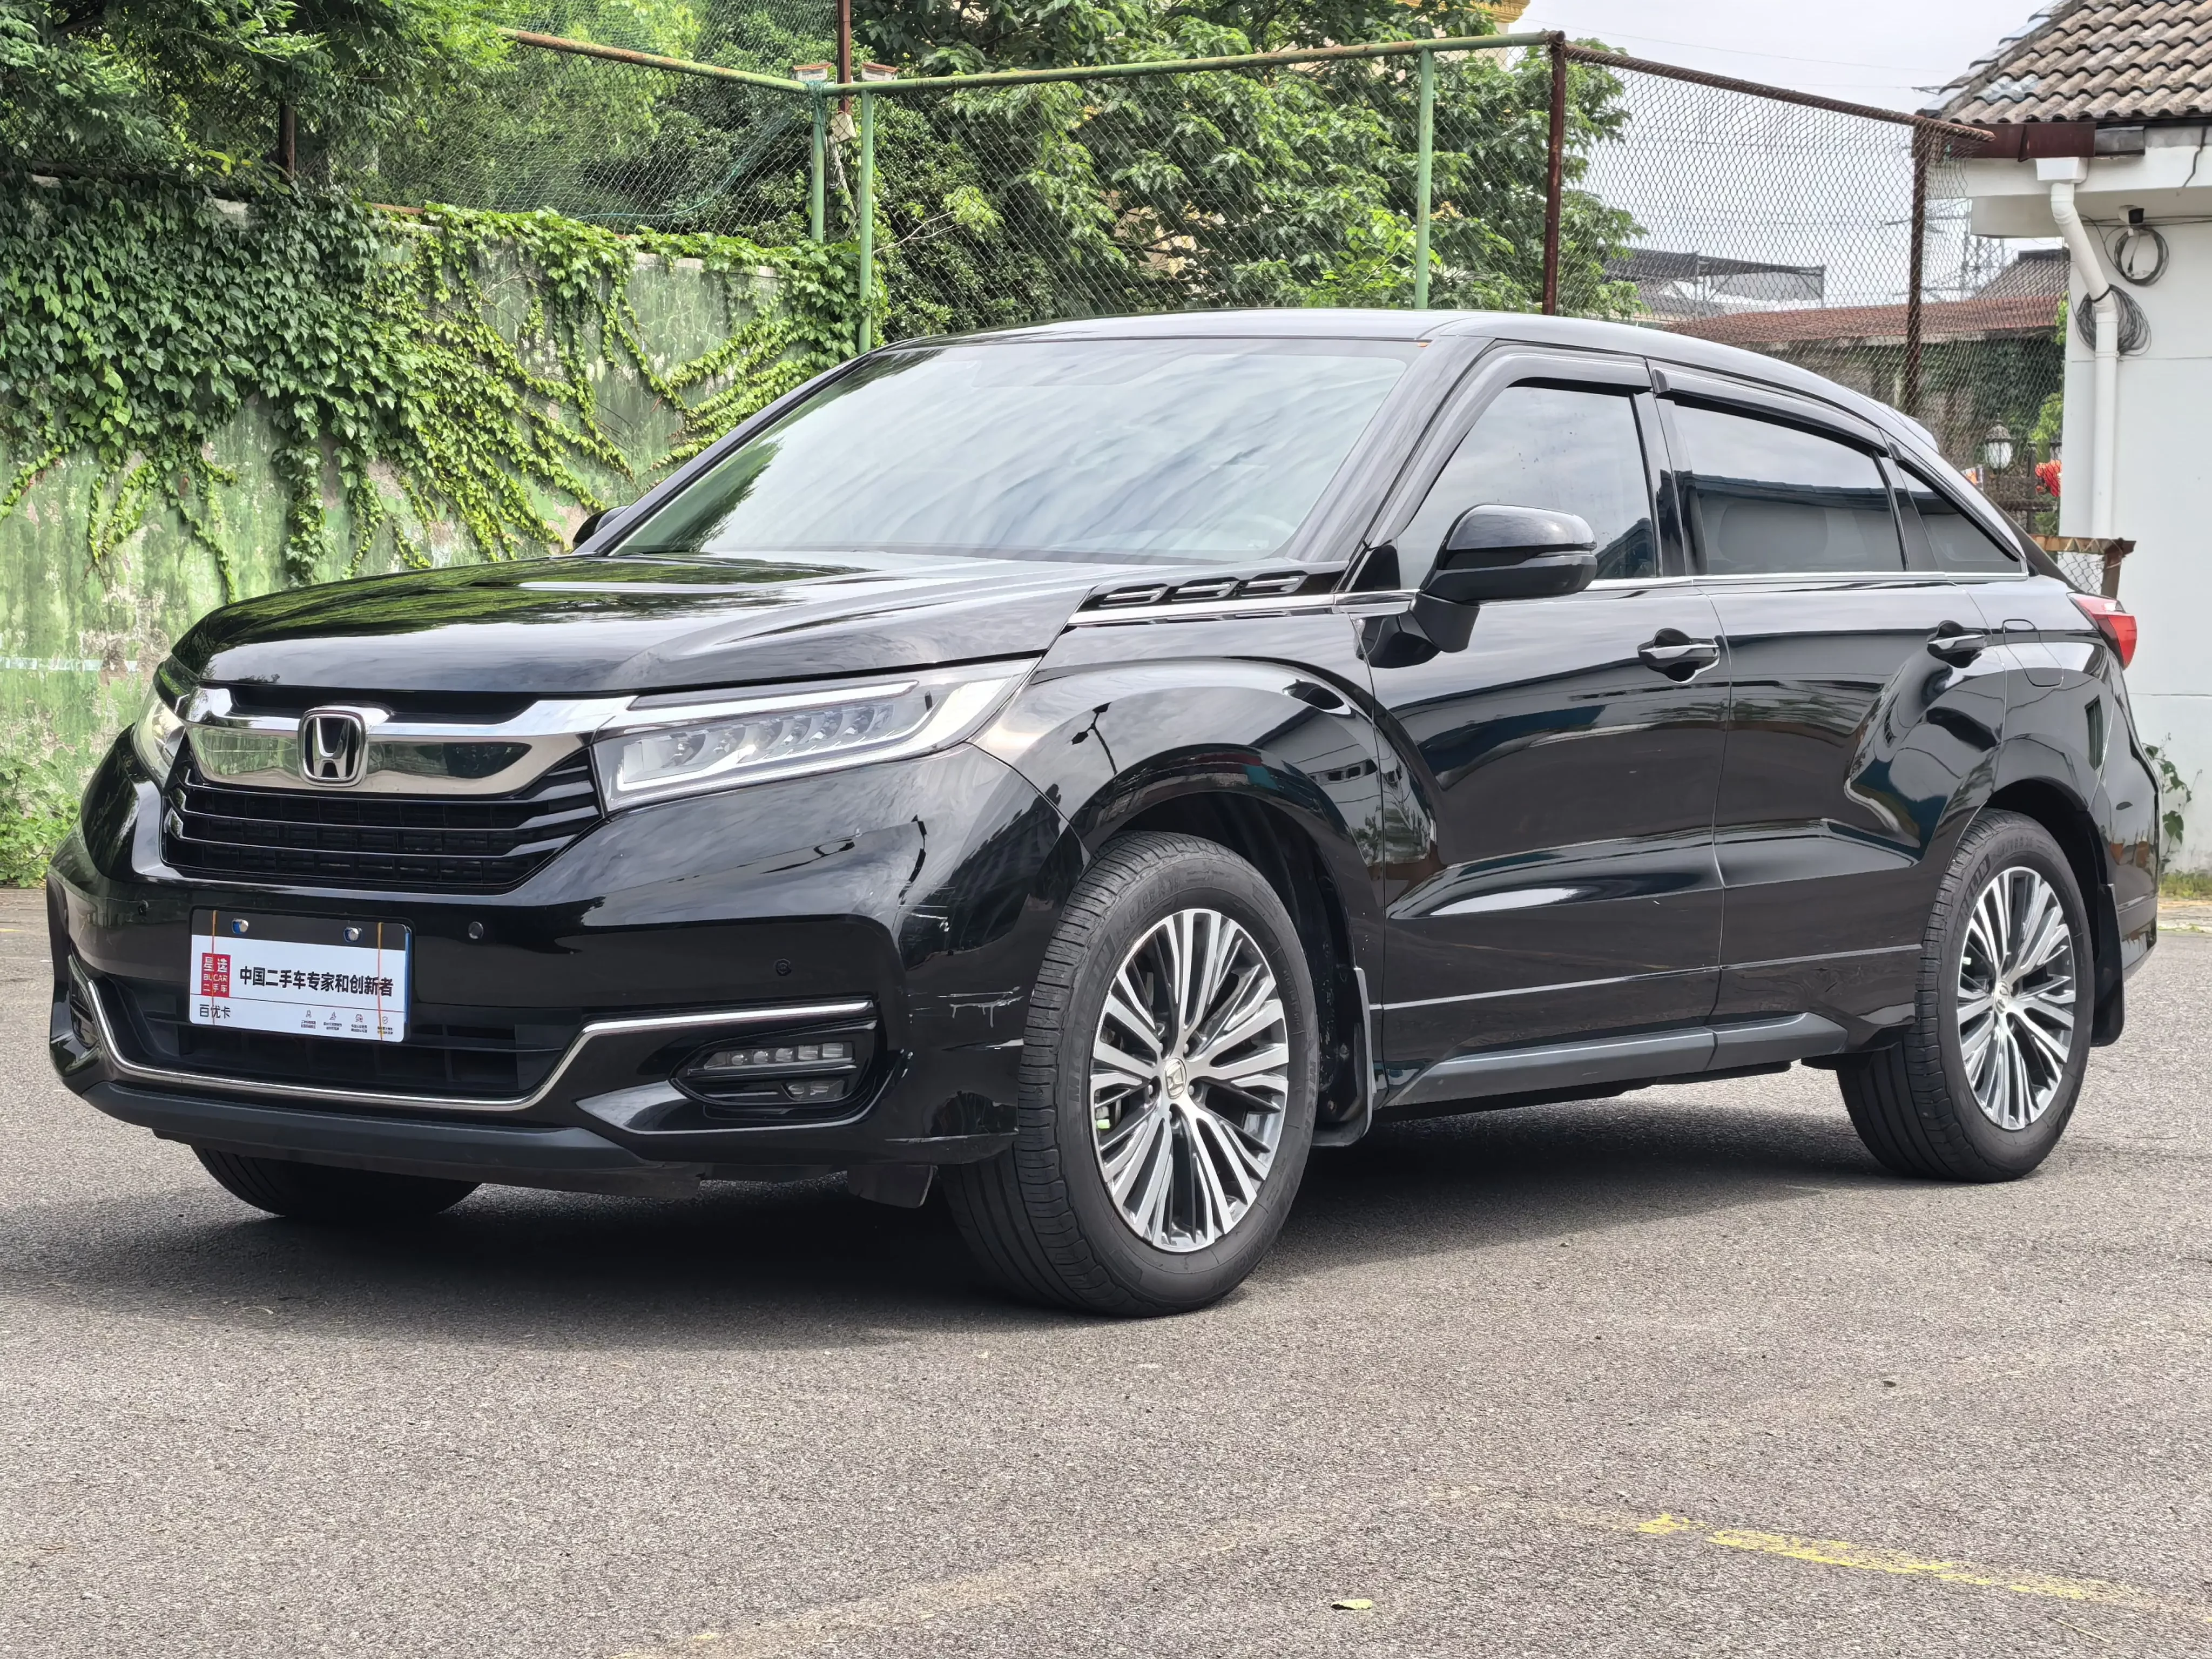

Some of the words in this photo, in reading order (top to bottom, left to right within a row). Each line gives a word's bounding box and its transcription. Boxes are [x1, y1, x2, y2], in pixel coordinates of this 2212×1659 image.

[240, 966, 394, 996] 中国二手车专家和创新者
[199, 1004, 231, 1019] 百优卡
